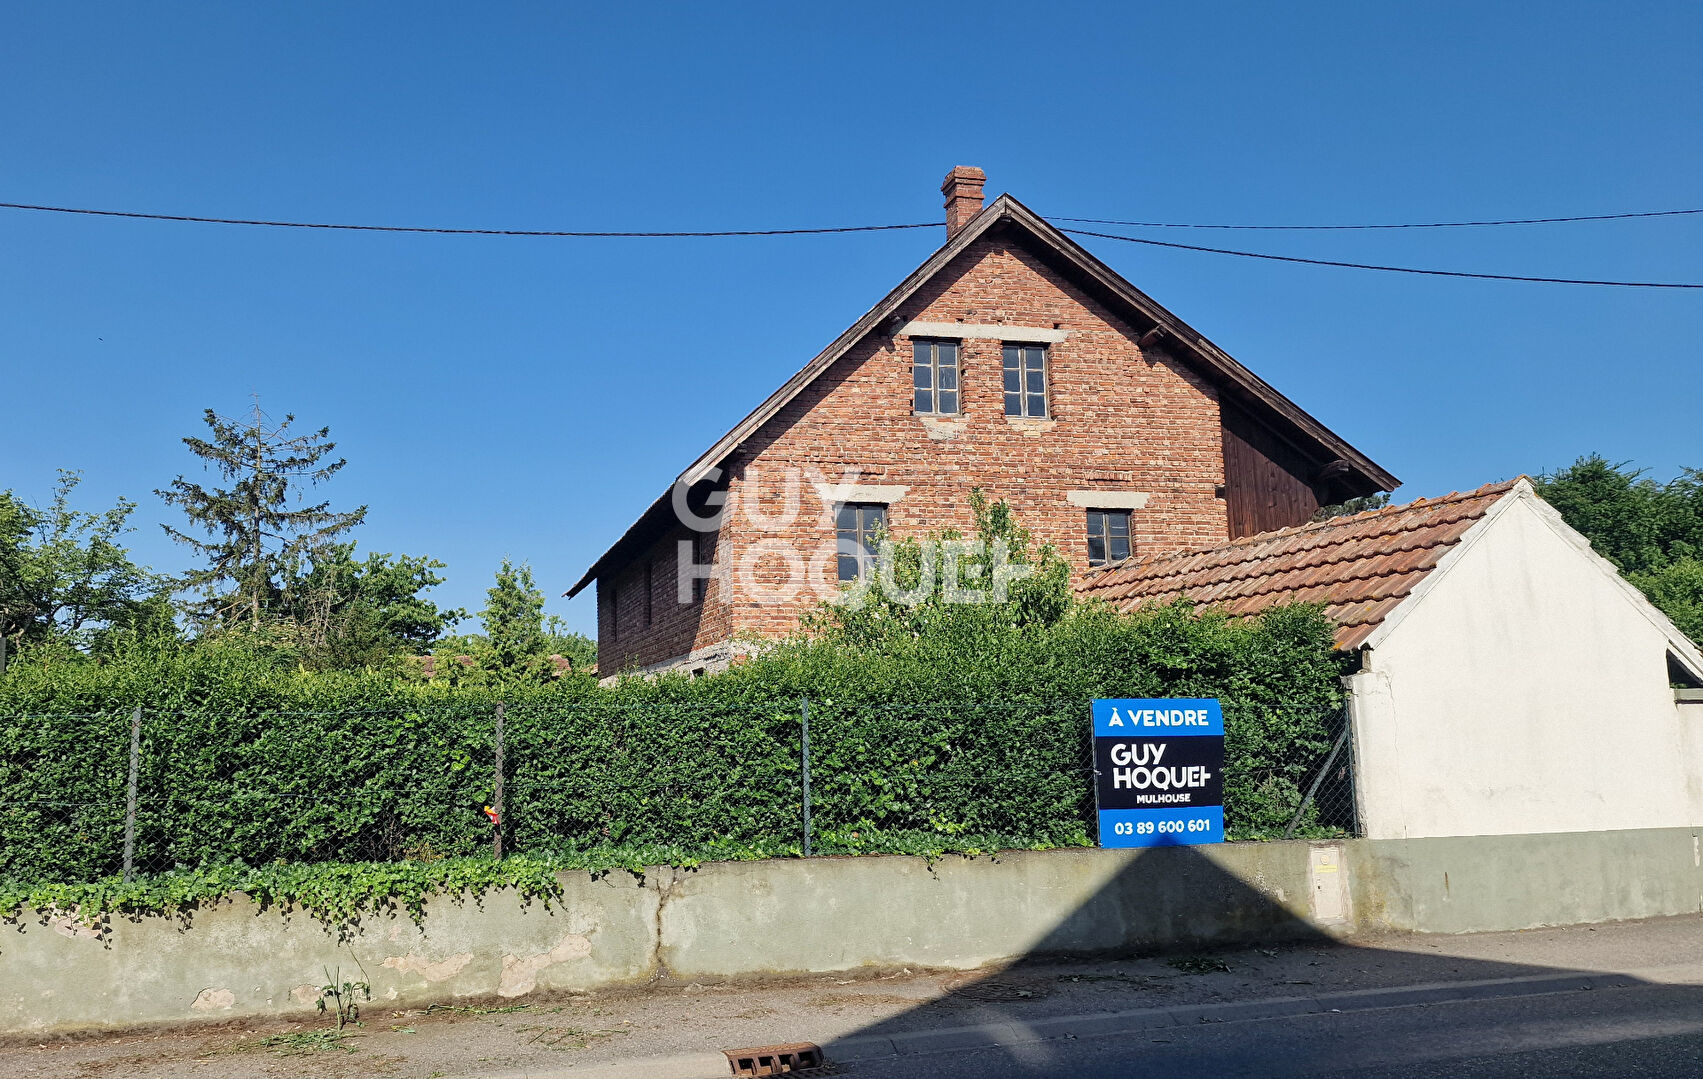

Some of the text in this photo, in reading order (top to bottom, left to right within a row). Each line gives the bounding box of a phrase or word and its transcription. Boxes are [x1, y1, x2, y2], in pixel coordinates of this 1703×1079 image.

[1108, 707, 1209, 727] À VENDRE
[1110, 743, 1167, 766] GUY
[1113, 766, 1211, 791] HOQUET
[1136, 793, 1191, 804] MULHOUSE
[1114, 819, 1210, 835] 03 89 600 601
